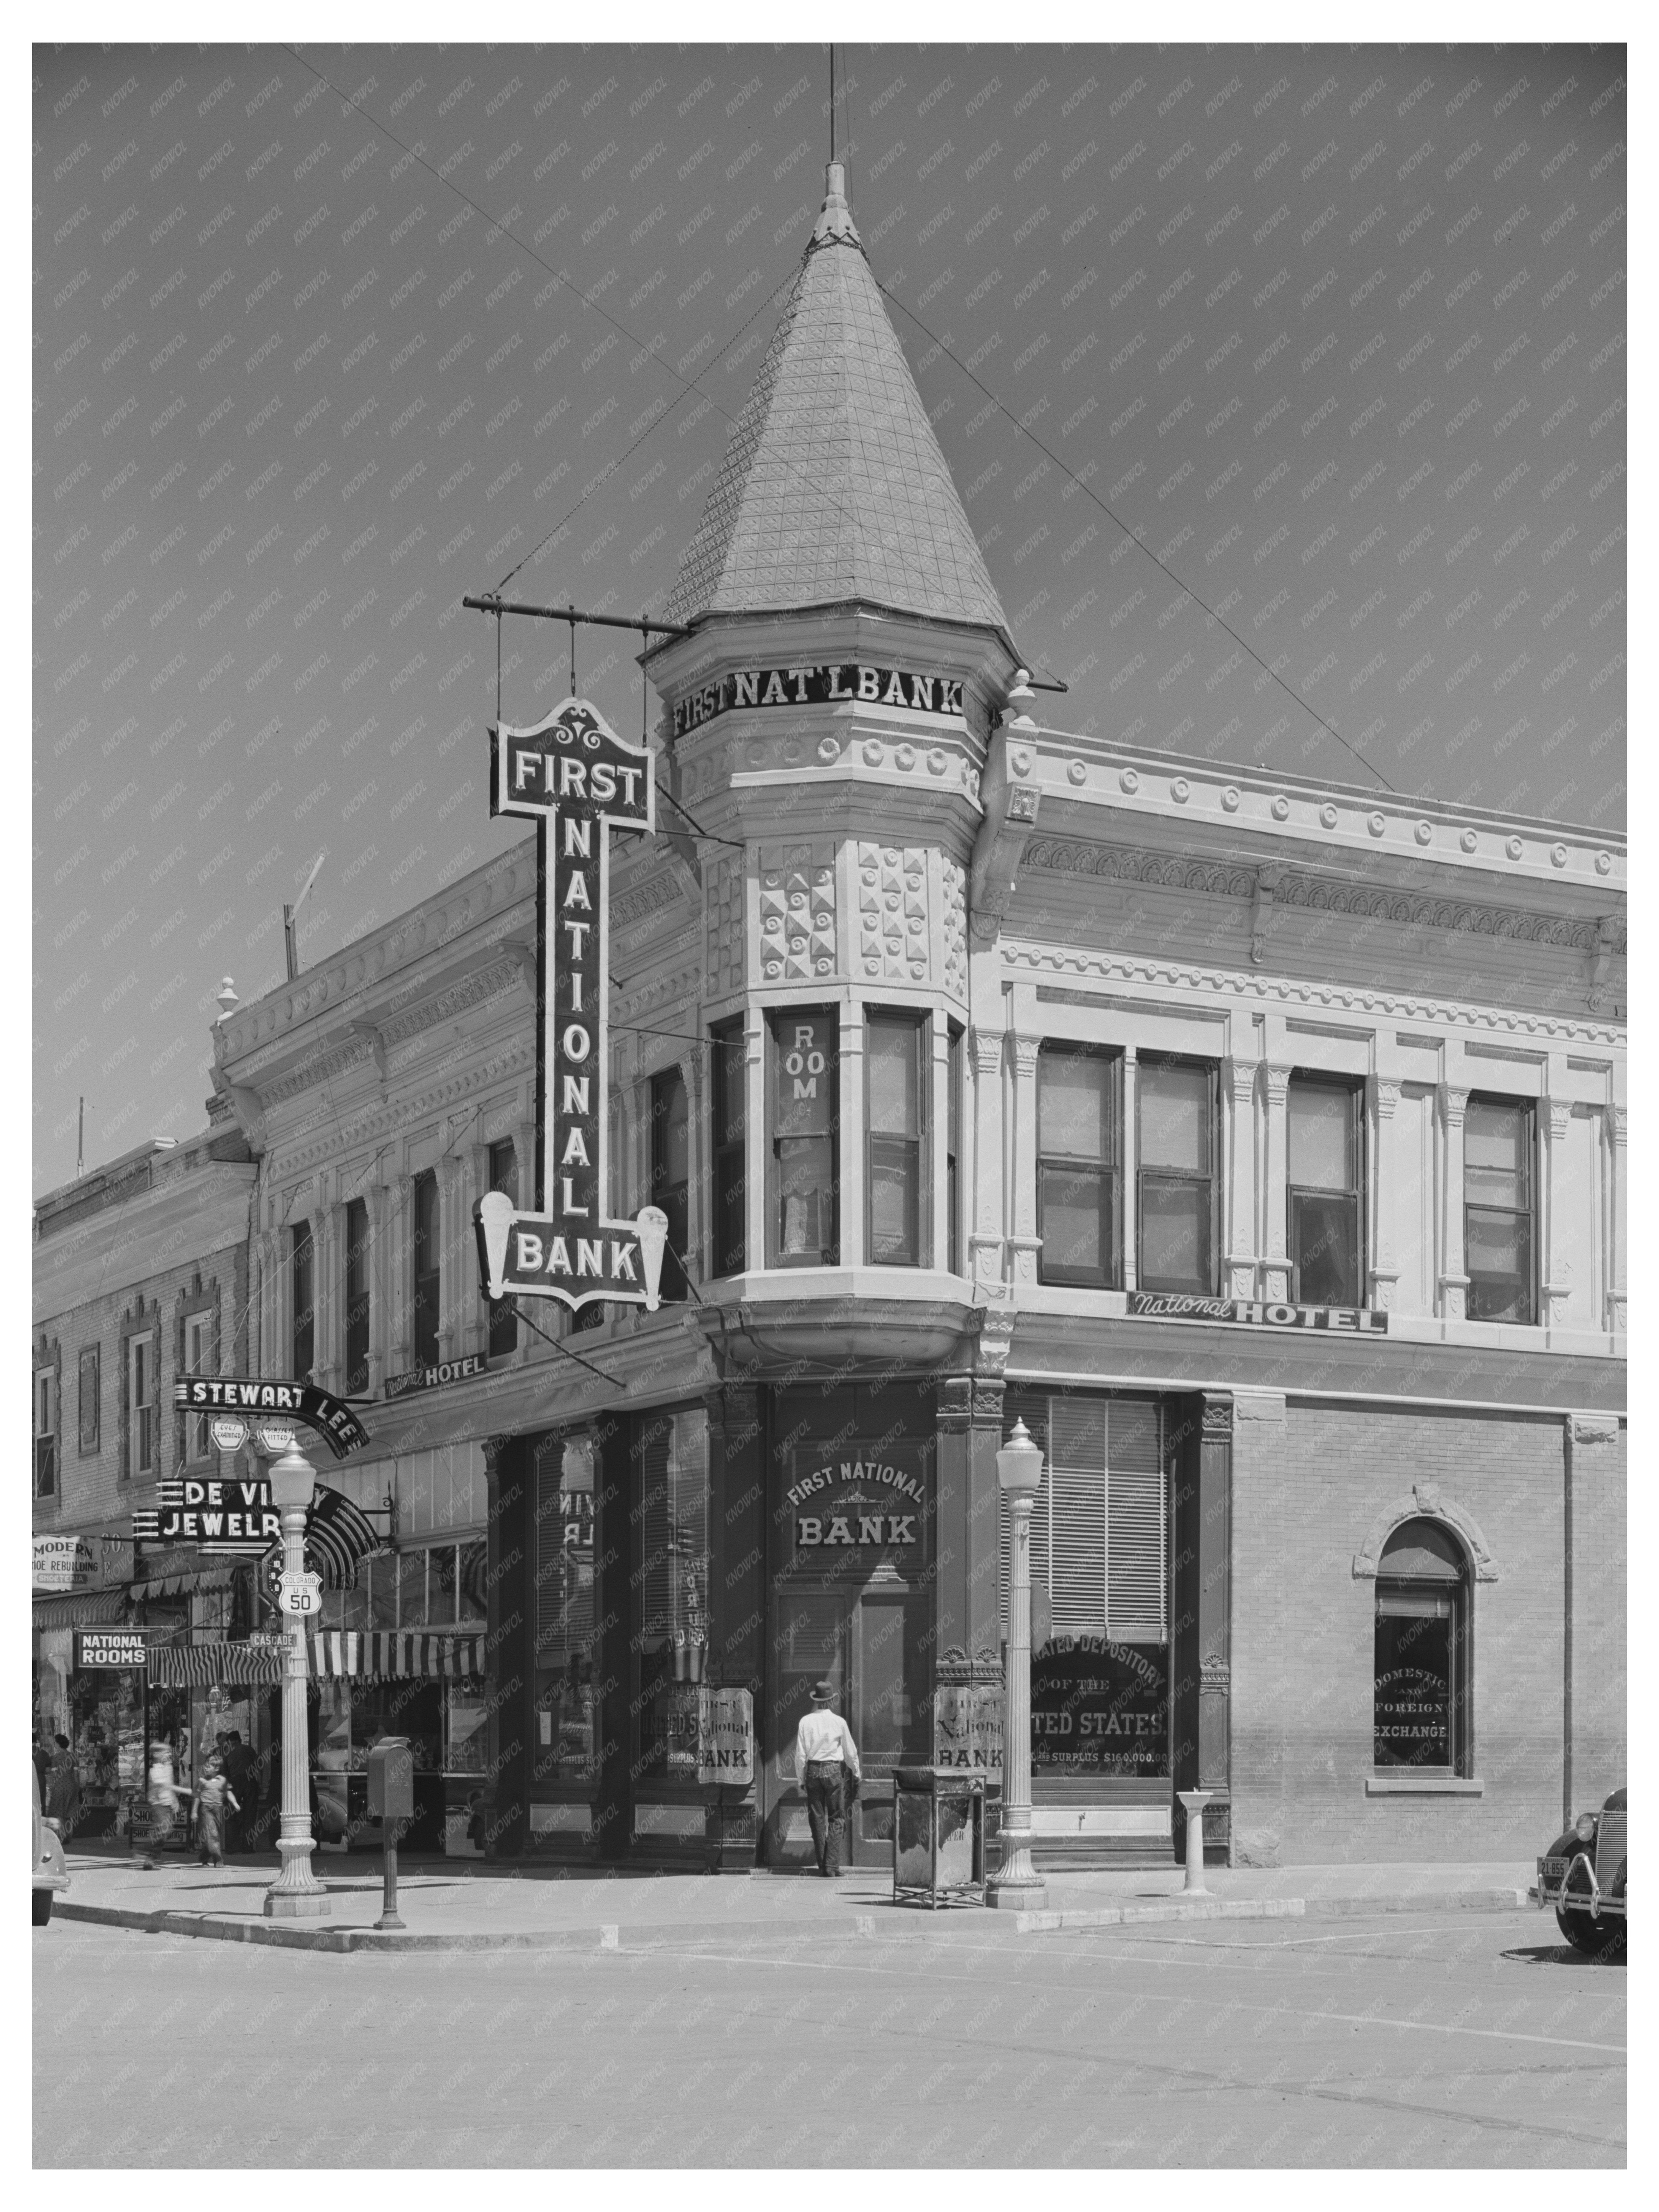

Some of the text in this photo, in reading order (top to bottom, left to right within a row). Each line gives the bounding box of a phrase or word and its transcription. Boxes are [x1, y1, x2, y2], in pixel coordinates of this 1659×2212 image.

[673, 677, 729, 736] FIRST
[857, 665, 963, 714] BANK
[516, 751, 642, 805] FIRST
[561, 817, 592, 1217] NATIONAL
[516, 1233, 638, 1281] BANK
[1135, 1294, 1385, 1331] National HOTEL
[426, 1356, 484, 1386] HOTEL
[193, 1382, 357, 1442] STEWART LEE
[185, 1482, 223, 1506] DE
[787, 1462, 925, 1506] FIRST NATIONAL
[163, 1513, 281, 1536] JEWELR
[798, 1516, 916, 1545] BANK
[33, 1542, 93, 1559] MODERN
[51, 1561, 98, 1572] REBUILDING
[290, 1595, 311, 1610] 50
[83, 1635, 146, 1648] NATIONAL
[254, 1635, 293, 1646] CASCADE
[83, 1650, 146, 1664] ROOMS
[1081, 1635, 1166, 1689] DEPOSITORY
[1051, 1679, 1110, 1690] OF THE
[1374, 1668, 1446, 1691] DOMESTIC
[1375, 1703, 1443, 1713] FOREIGN
[939, 1749, 1003, 1767] BANK
[1051, 1752, 1098, 1762] SURPLUS
